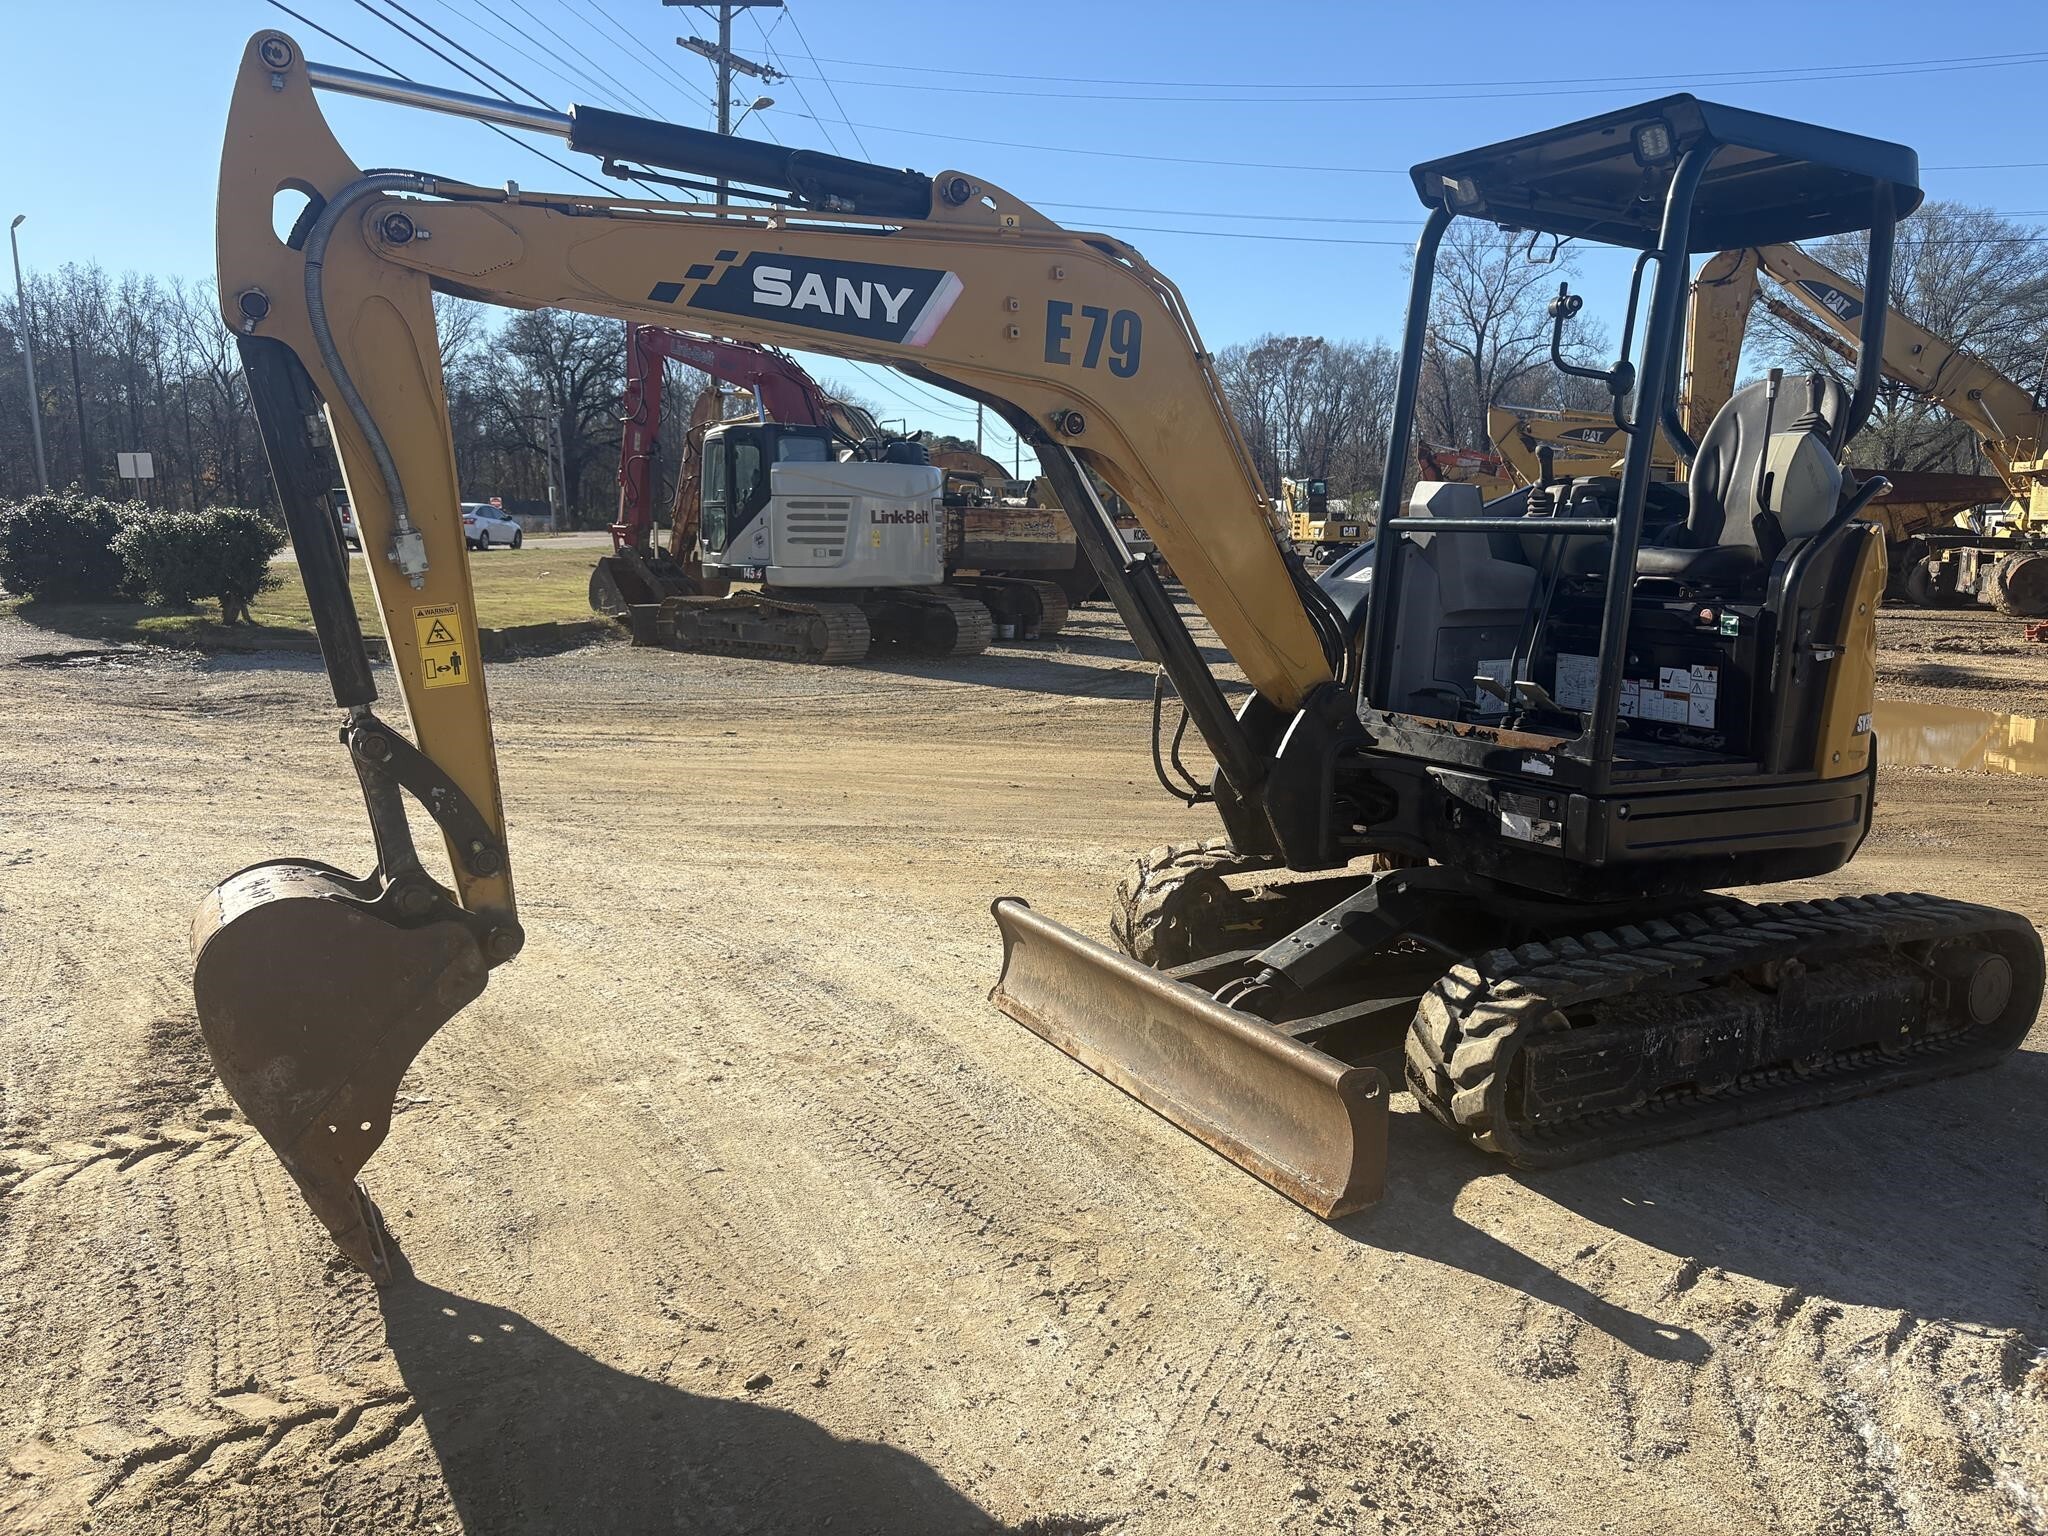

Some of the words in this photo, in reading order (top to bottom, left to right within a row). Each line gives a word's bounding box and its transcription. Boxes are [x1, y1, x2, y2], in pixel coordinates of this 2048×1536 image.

[752, 265, 914, 324] SANY
[1822, 289, 1852, 316] CAT
[1582, 428, 1604, 442] CAT
[1343, 526, 1357, 537] CAT
[424, 606, 454, 616] WARNING
